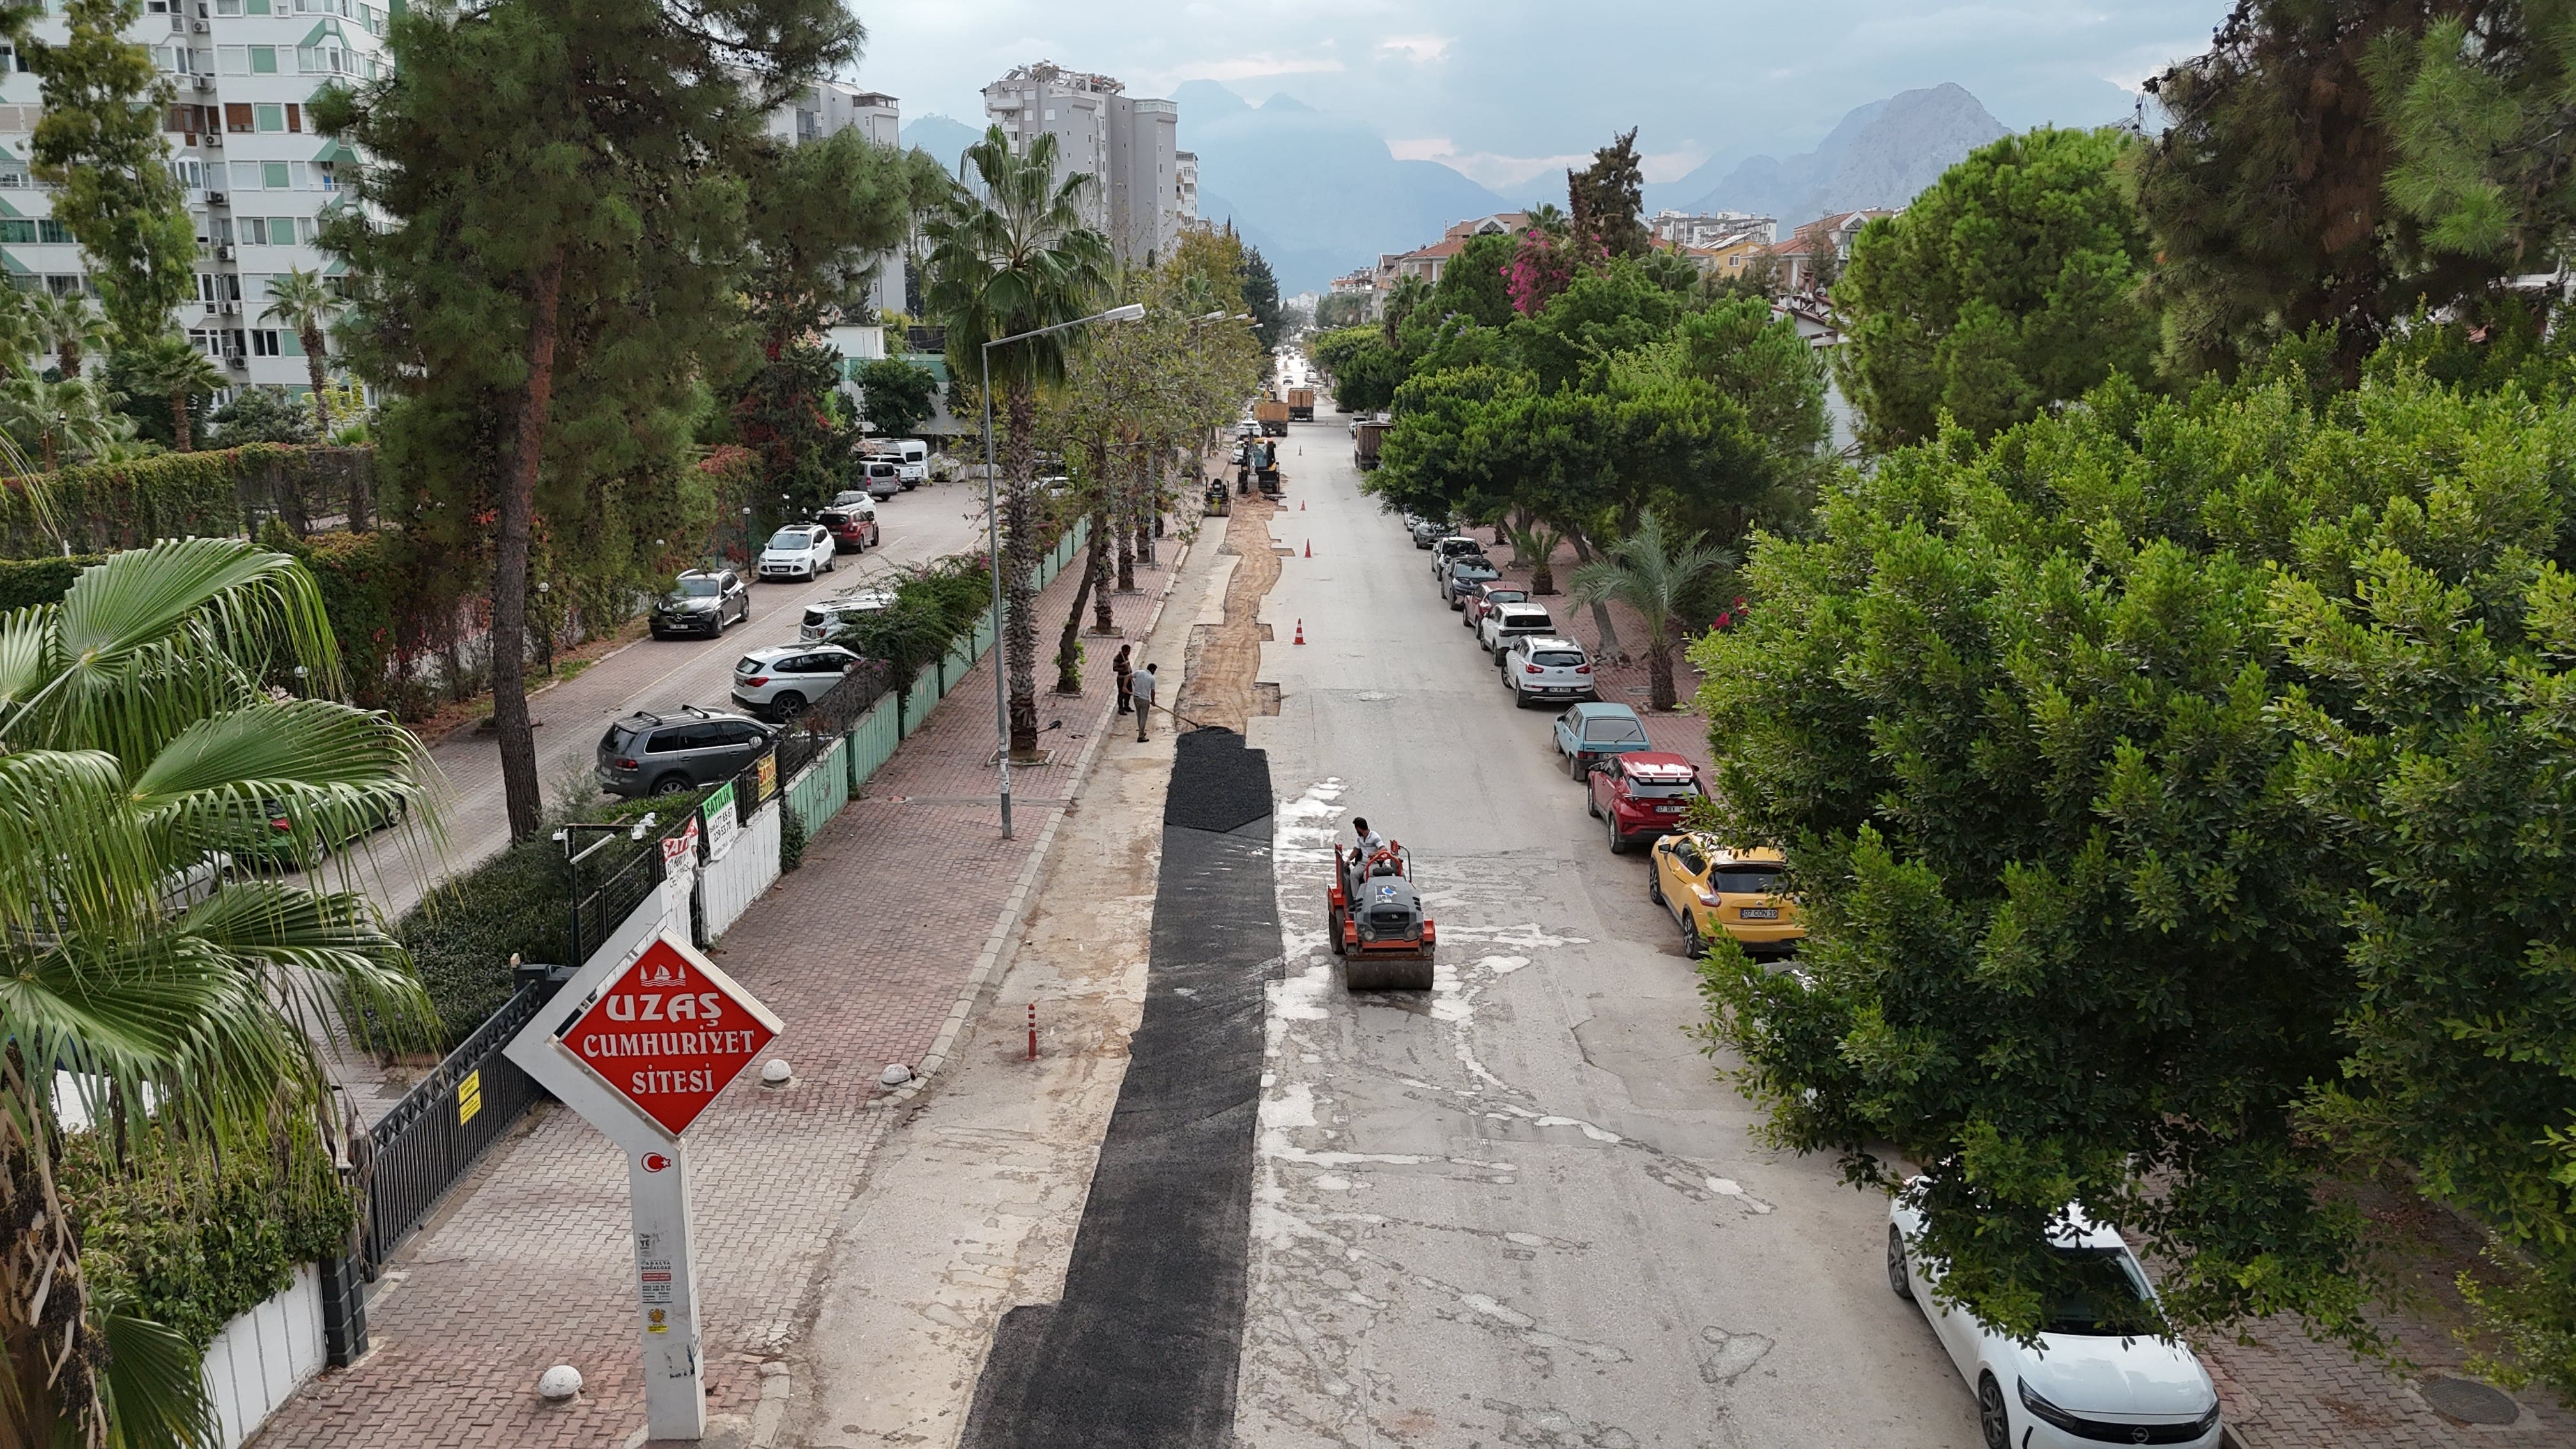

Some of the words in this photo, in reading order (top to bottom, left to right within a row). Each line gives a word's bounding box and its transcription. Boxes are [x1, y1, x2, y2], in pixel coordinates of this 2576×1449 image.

[706, 786, 731, 818] SATILIK
[606, 993, 722, 1027] UZAŞ
[583, 1024, 755, 1058] CUMHURİYET
[632, 1063, 714, 1094] SİTESİ
